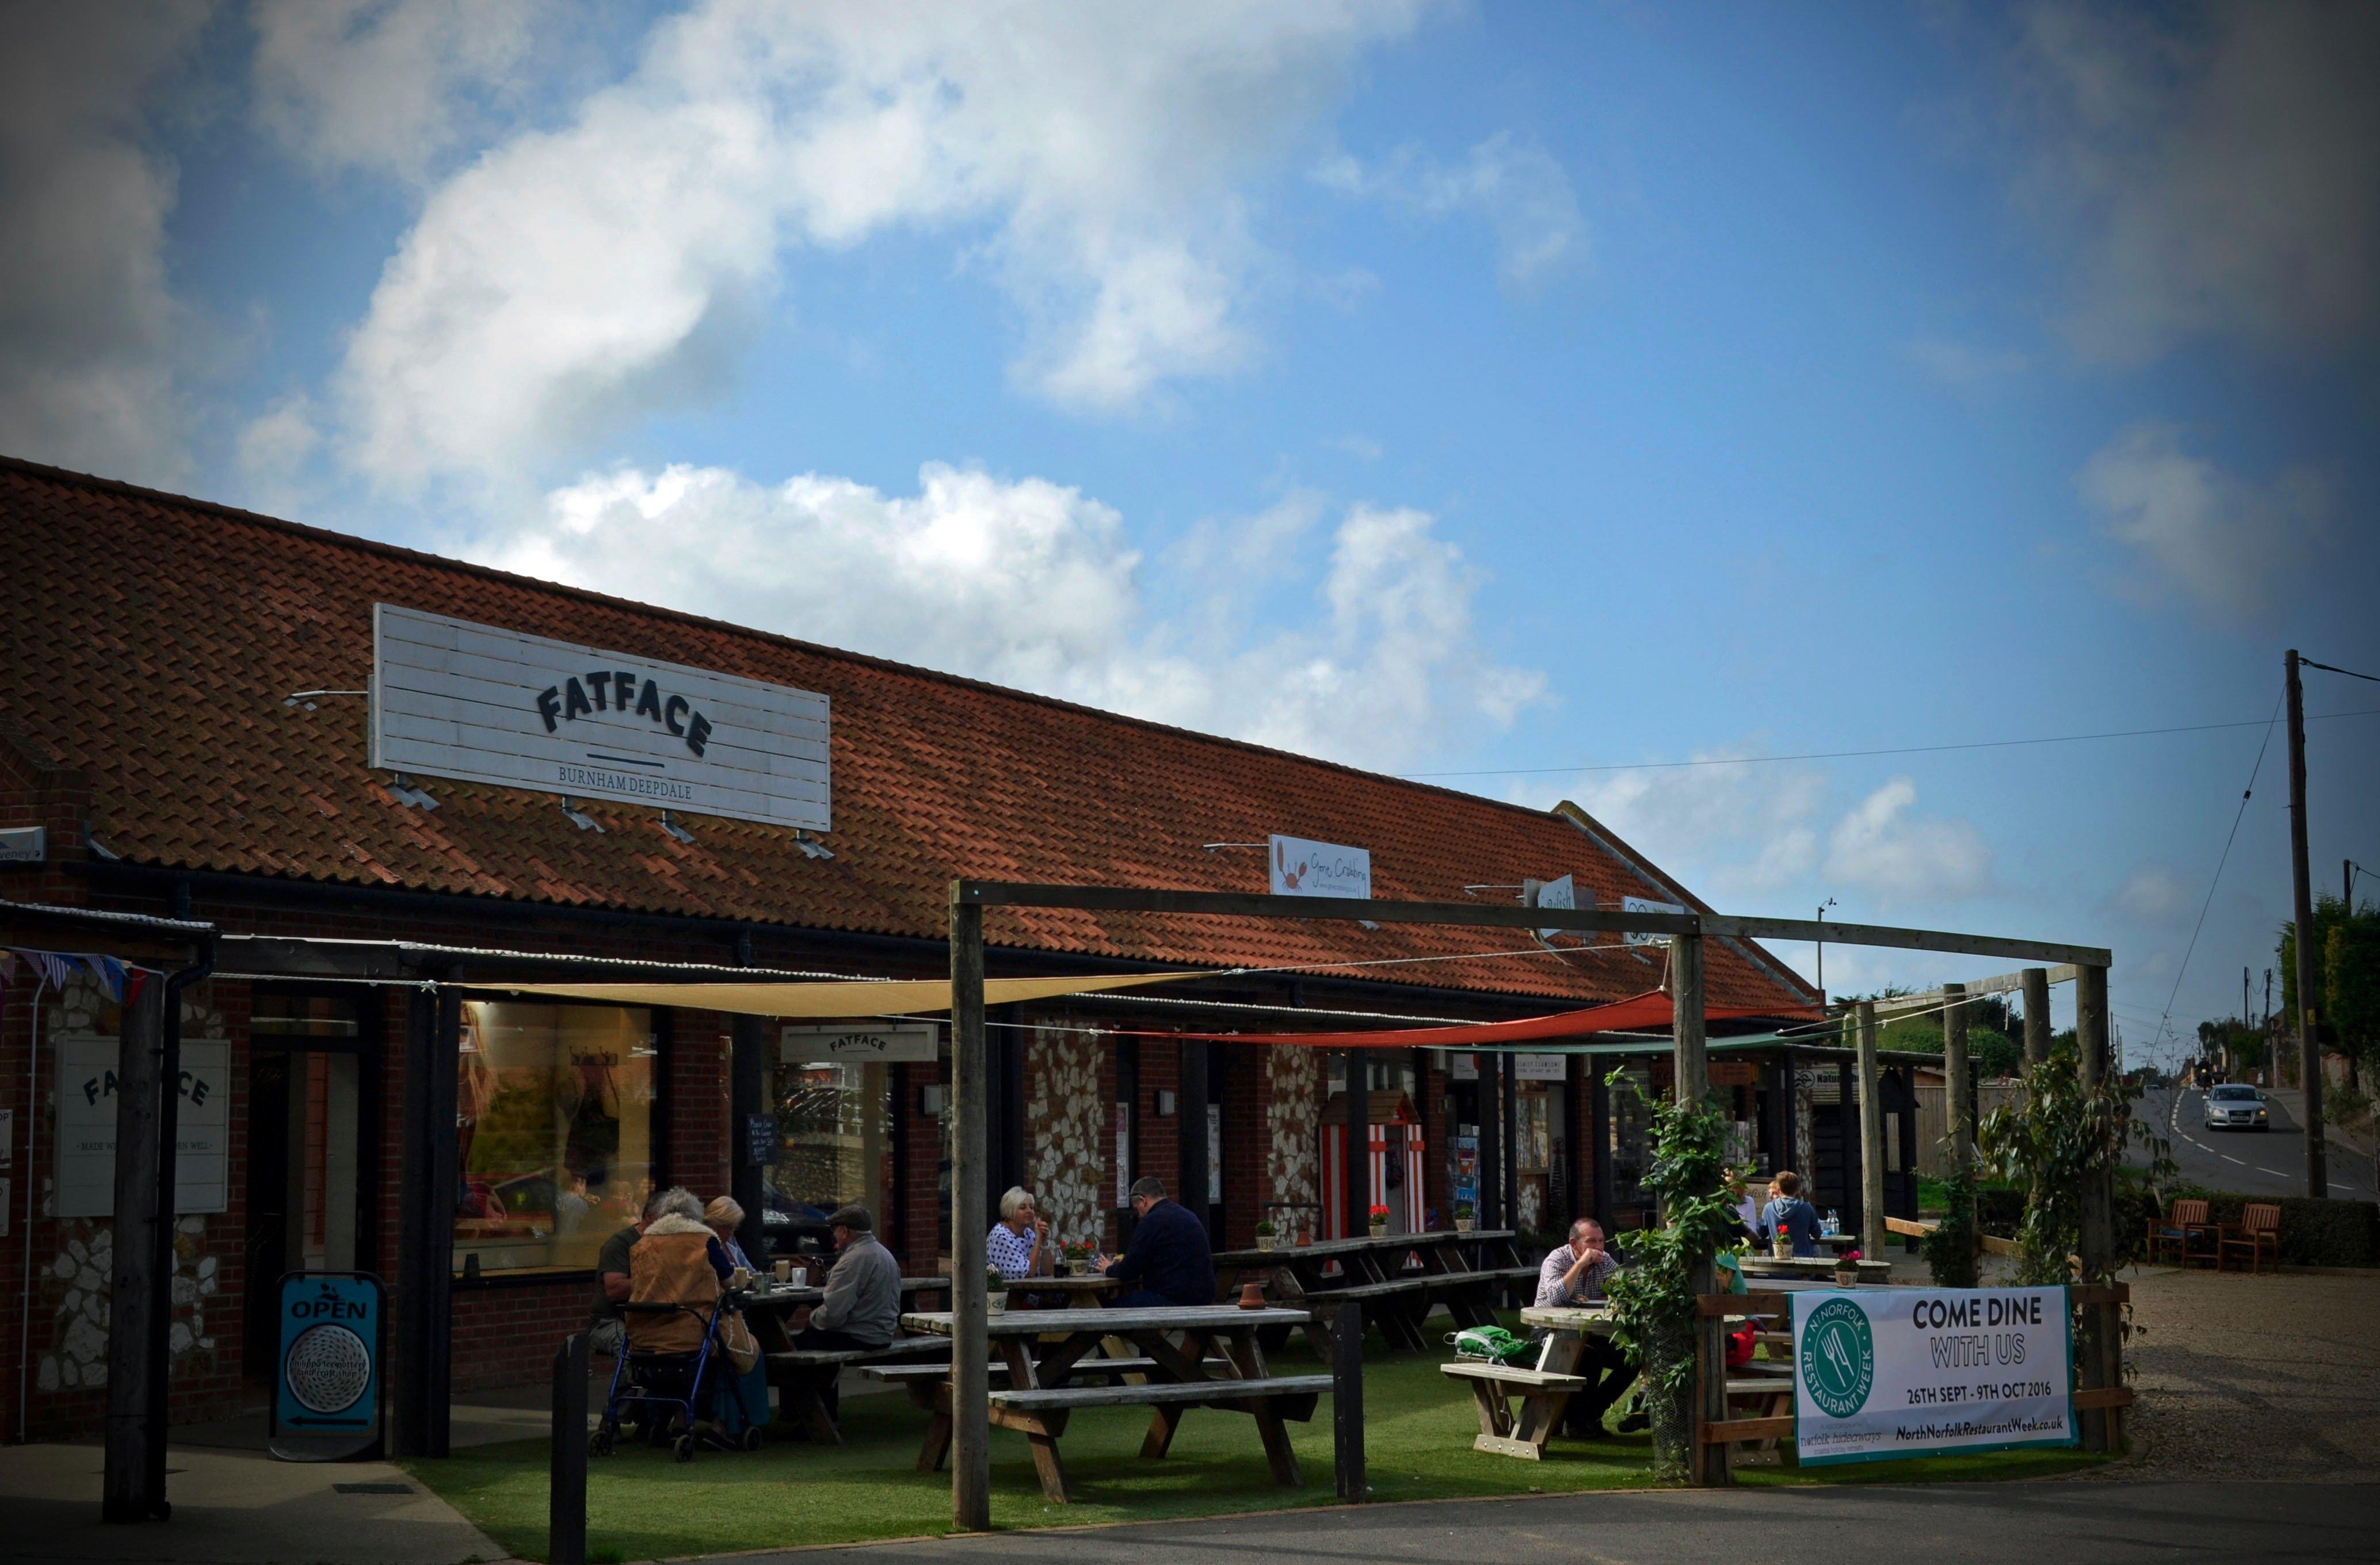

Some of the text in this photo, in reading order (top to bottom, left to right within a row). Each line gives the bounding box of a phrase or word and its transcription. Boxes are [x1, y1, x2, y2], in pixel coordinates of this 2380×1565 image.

[536, 671, 712, 757] FATFACE
[559, 767, 692, 800] BURNHAM DEEPDALE
[830, 1035, 887, 1052] FATFACE
[81, 1143, 103, 1151] MADE
[191, 1142, 209, 1150] WELL
[292, 1301, 367, 1319] OPEN
[1913, 1297, 2041, 1329] COME DINE
[1931, 1333, 2026, 1368] WITH US
[289, 1360, 321, 1368] philippa
[337, 1361, 367, 1369] pottery
[338, 1370, 357, 1378] shop
[1803, 1349, 1871, 1413] RESTAURANT WEEK
[1907, 1387, 1936, 1404] 26TH
[1940, 1385, 1967, 1402] SEPT
[1977, 1384, 1999, 1400] 9TH
[2002, 1382, 2026, 1398] OCT
[2028, 1381, 2051, 1397] 2016
[1801, 1432, 1882, 1446] norfolk hideaways
[1896, 1415, 2063, 1441] NorthNorfolkRestaurantWeek.co.uk
